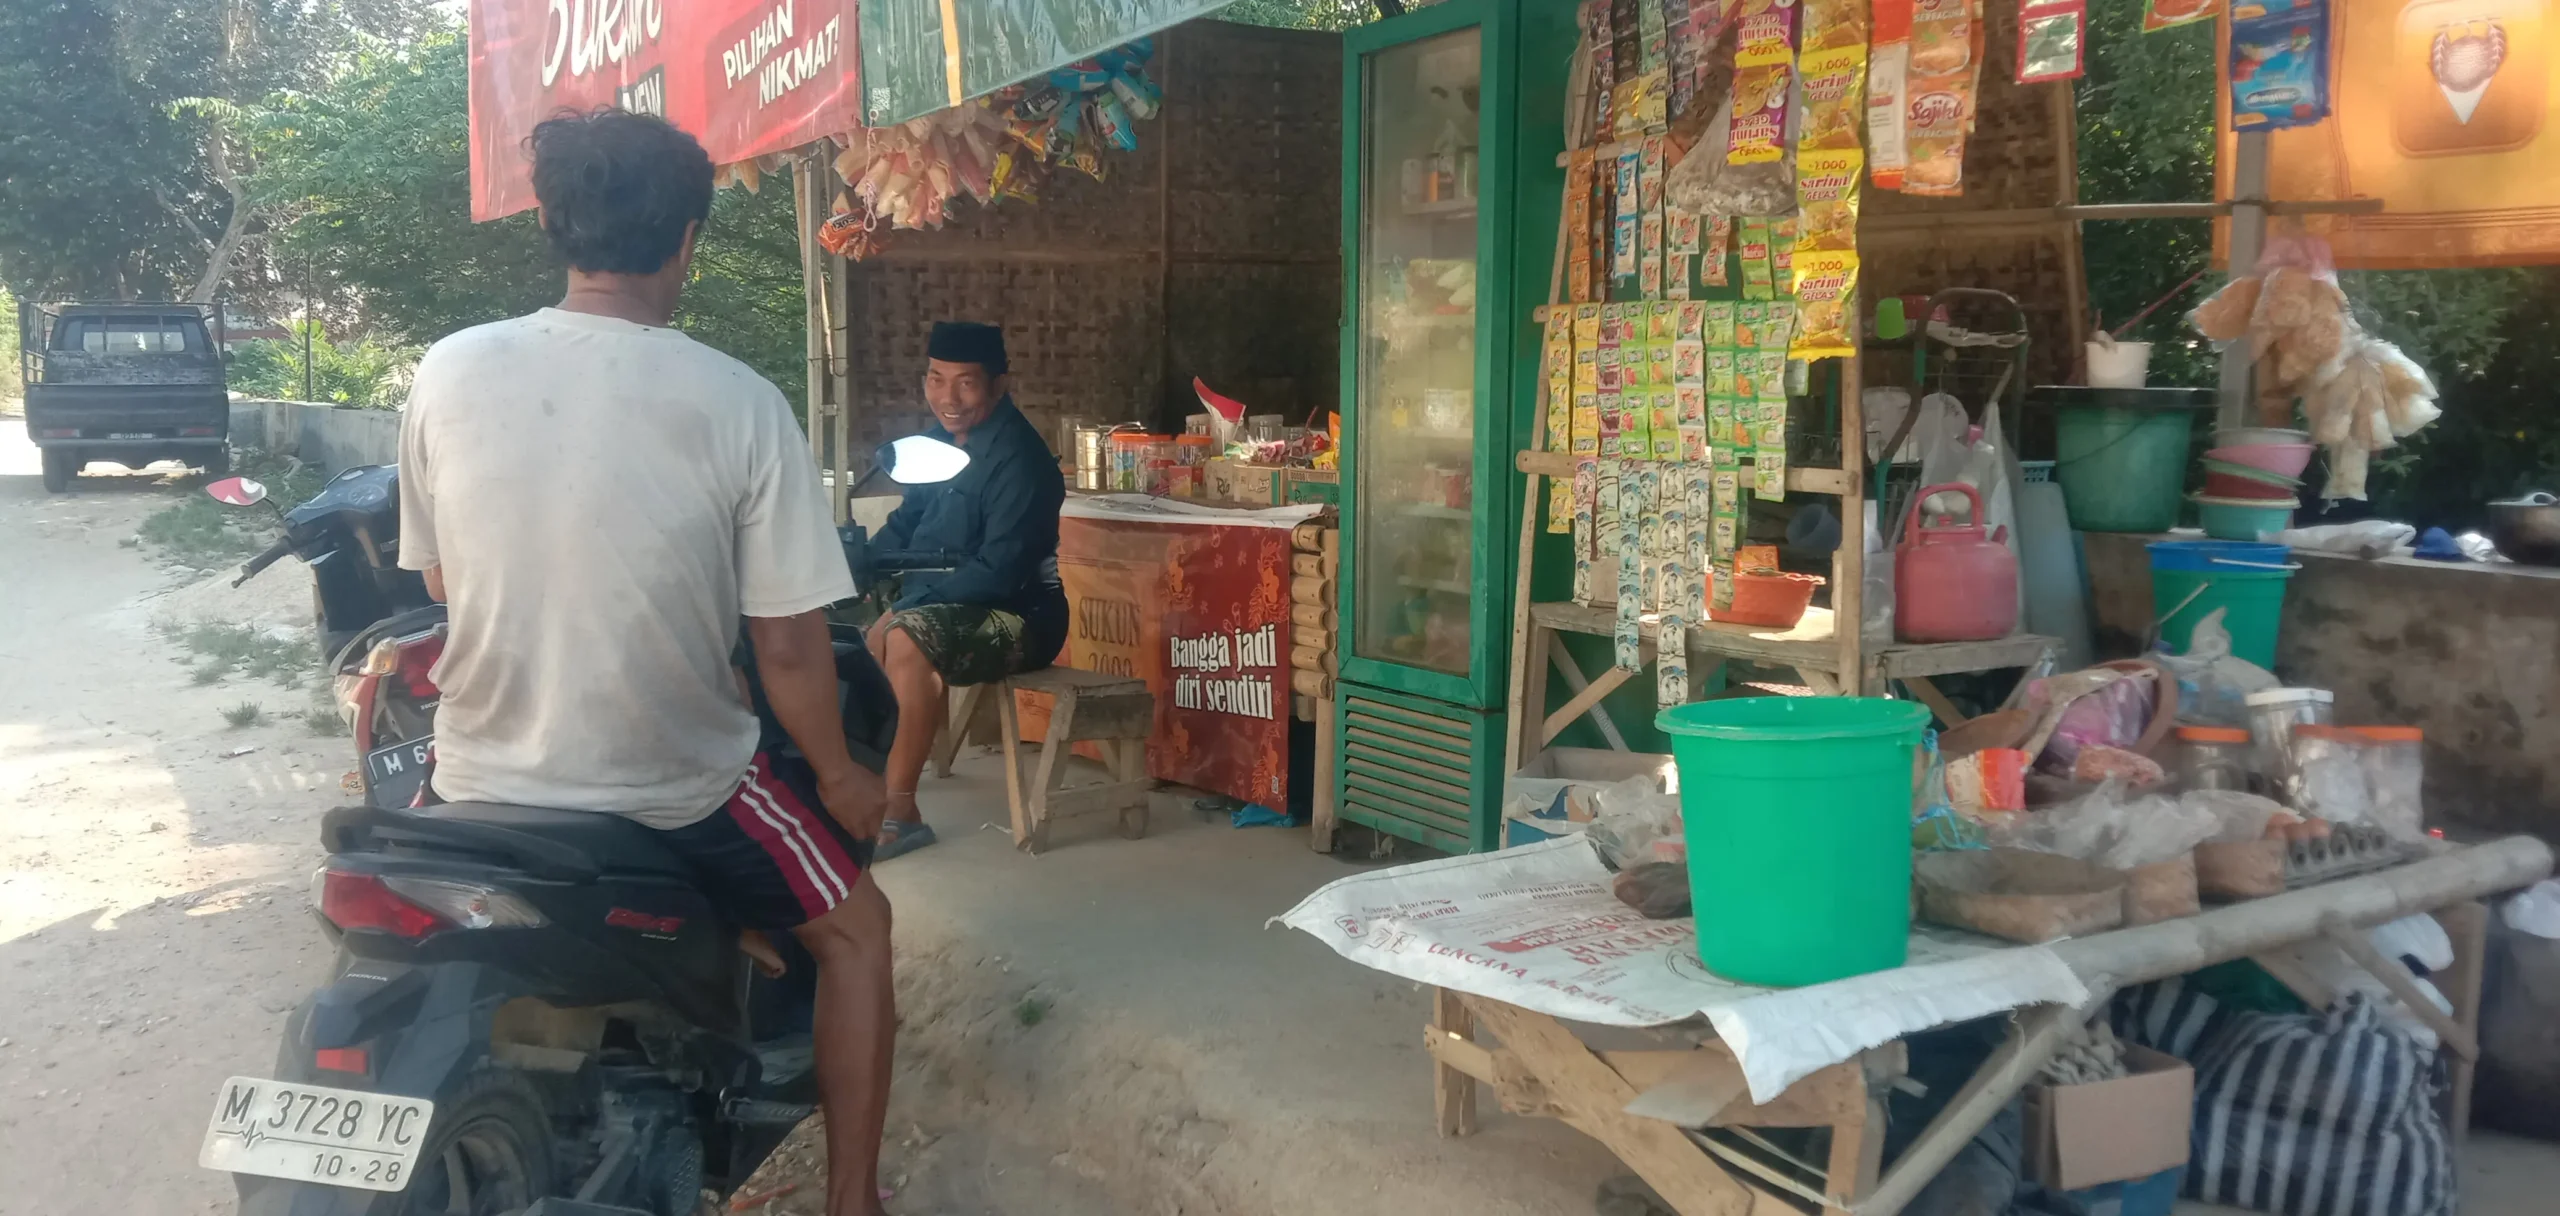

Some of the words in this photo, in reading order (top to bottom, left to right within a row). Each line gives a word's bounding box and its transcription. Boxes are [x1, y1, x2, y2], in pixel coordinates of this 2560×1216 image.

[722, 0, 793, 90] PILIHAN
[759, 13, 840, 111] NIKMAT!
[1803, 68, 1854, 90] sarimi
[1731, 127, 1778, 145] sarimi
[1800, 171, 1851, 189] sarimi
[1805, 190, 1838, 201] GELAS
[1799, 272, 1847, 290] sarimi
[1802, 291, 1836, 301] GELAS
[1079, 595, 1142, 648] SUKUN
[1170, 631, 1231, 673] Bangga
[1234, 623, 1278, 671] jadi
[1175, 673, 1202, 711] diri
[1205, 674, 1274, 721] sendiri
[383, 752, 404, 776] M
[1427, 942, 1529, 980] LENCANA
[220, 1084, 256, 1125] M
[267, 1090, 363, 1139] 3728
[376, 1103, 420, 1146] YC
